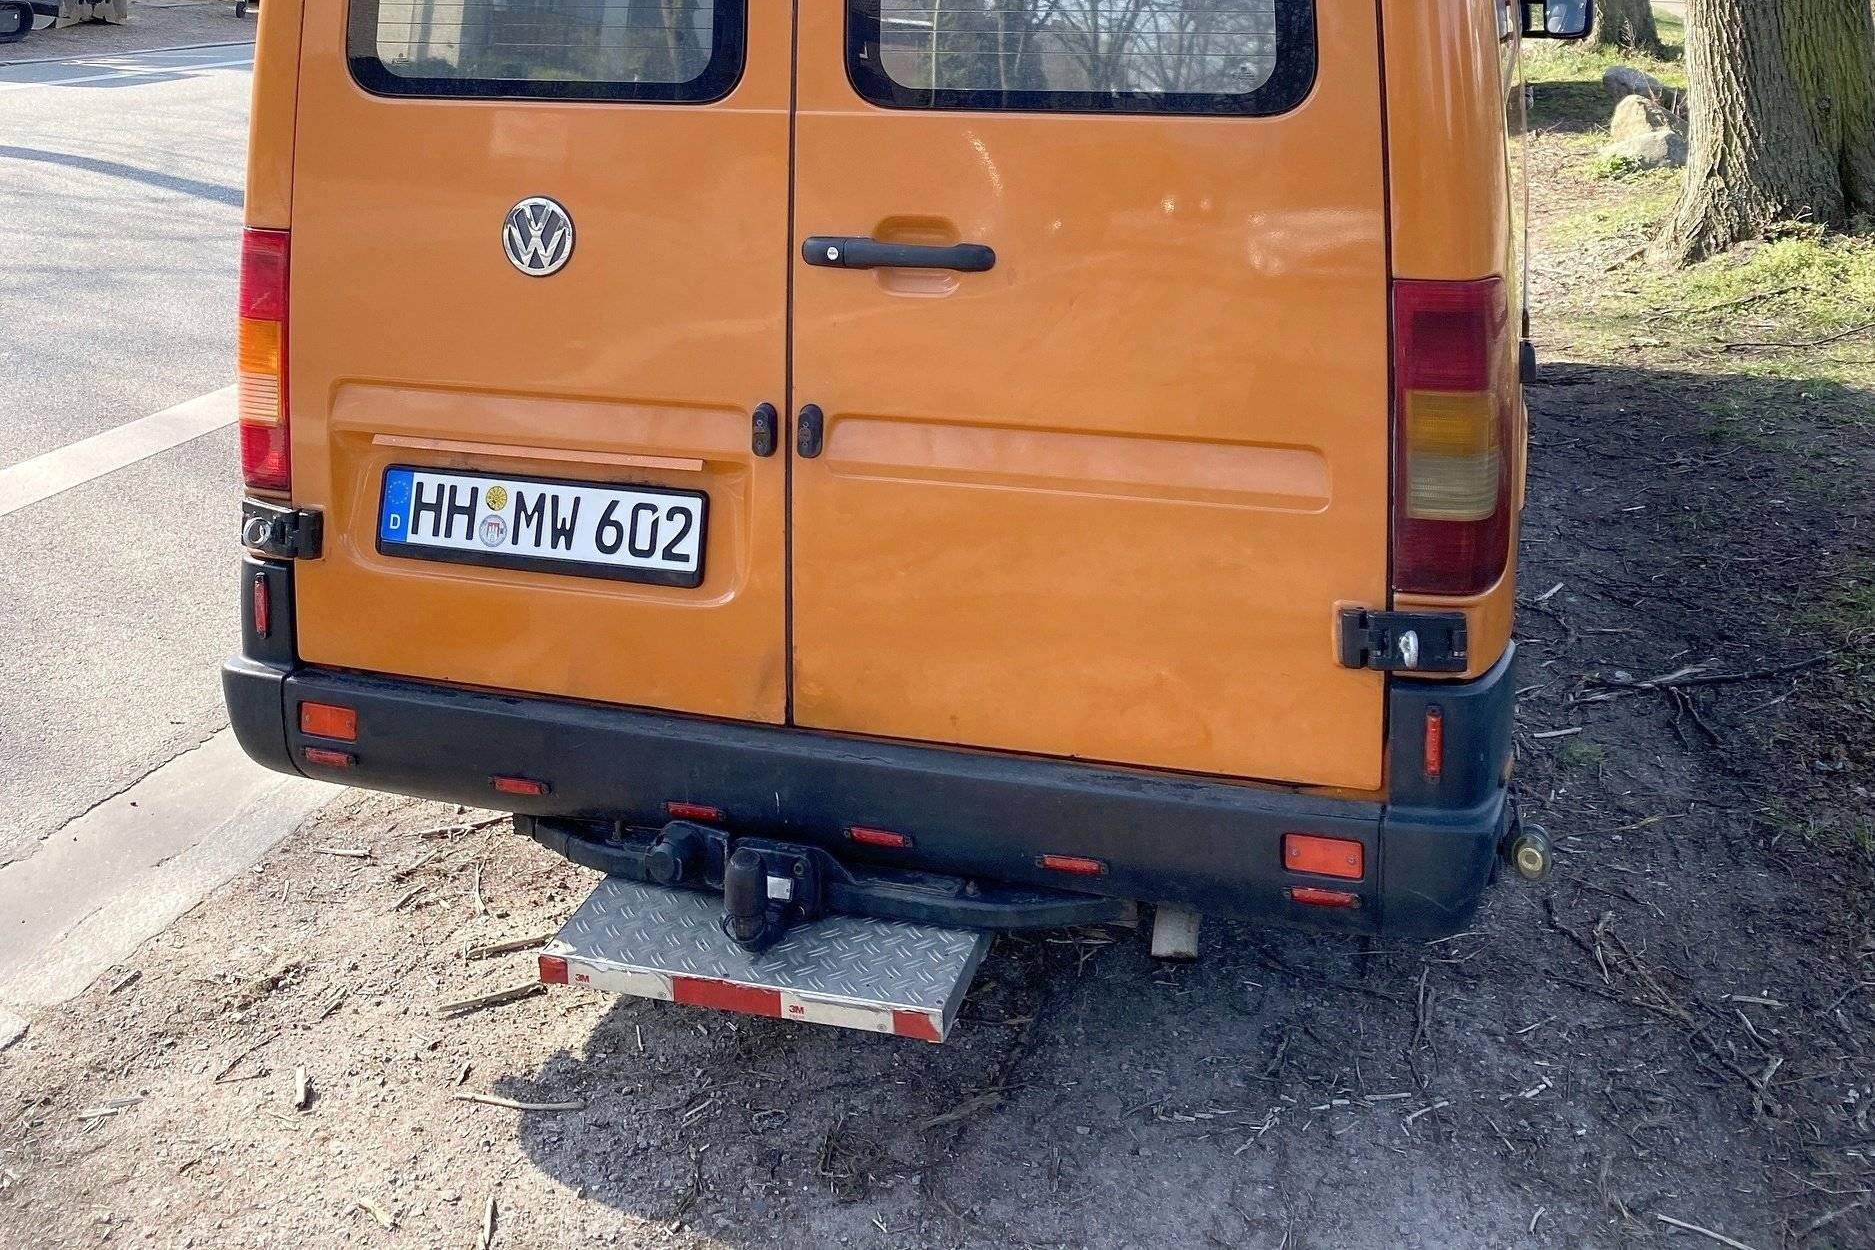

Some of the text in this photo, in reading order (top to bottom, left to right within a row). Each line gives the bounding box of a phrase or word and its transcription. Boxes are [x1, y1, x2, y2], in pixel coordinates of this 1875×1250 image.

[504, 198, 572, 275] VW
[390, 513, 401, 530] D
[411, 481, 694, 563] HH MW 602
[575, 973, 590, 983] 3M
[789, 1004, 805, 1015] 3M
